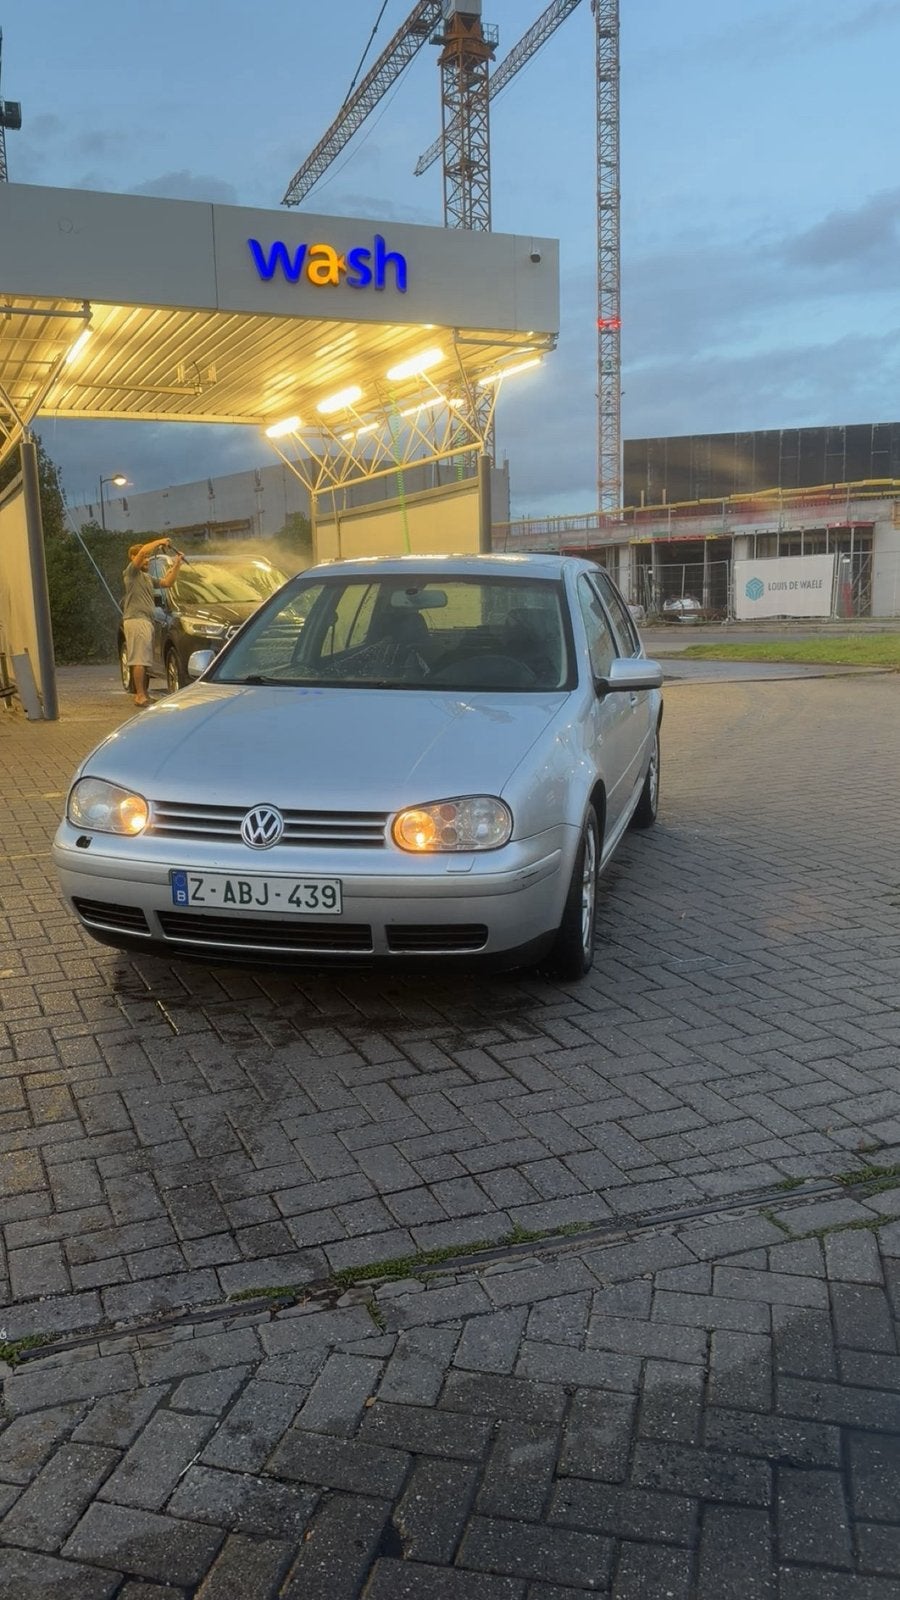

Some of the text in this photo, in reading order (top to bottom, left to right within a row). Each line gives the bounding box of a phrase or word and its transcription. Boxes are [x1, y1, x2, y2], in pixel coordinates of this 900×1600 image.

[248, 234, 407, 293] wash
[768, 579, 823, 591] LOUIS DE WAELE
[245, 809, 281, 847] VW
[177, 877, 337, 909] B Z-ABJ-439
